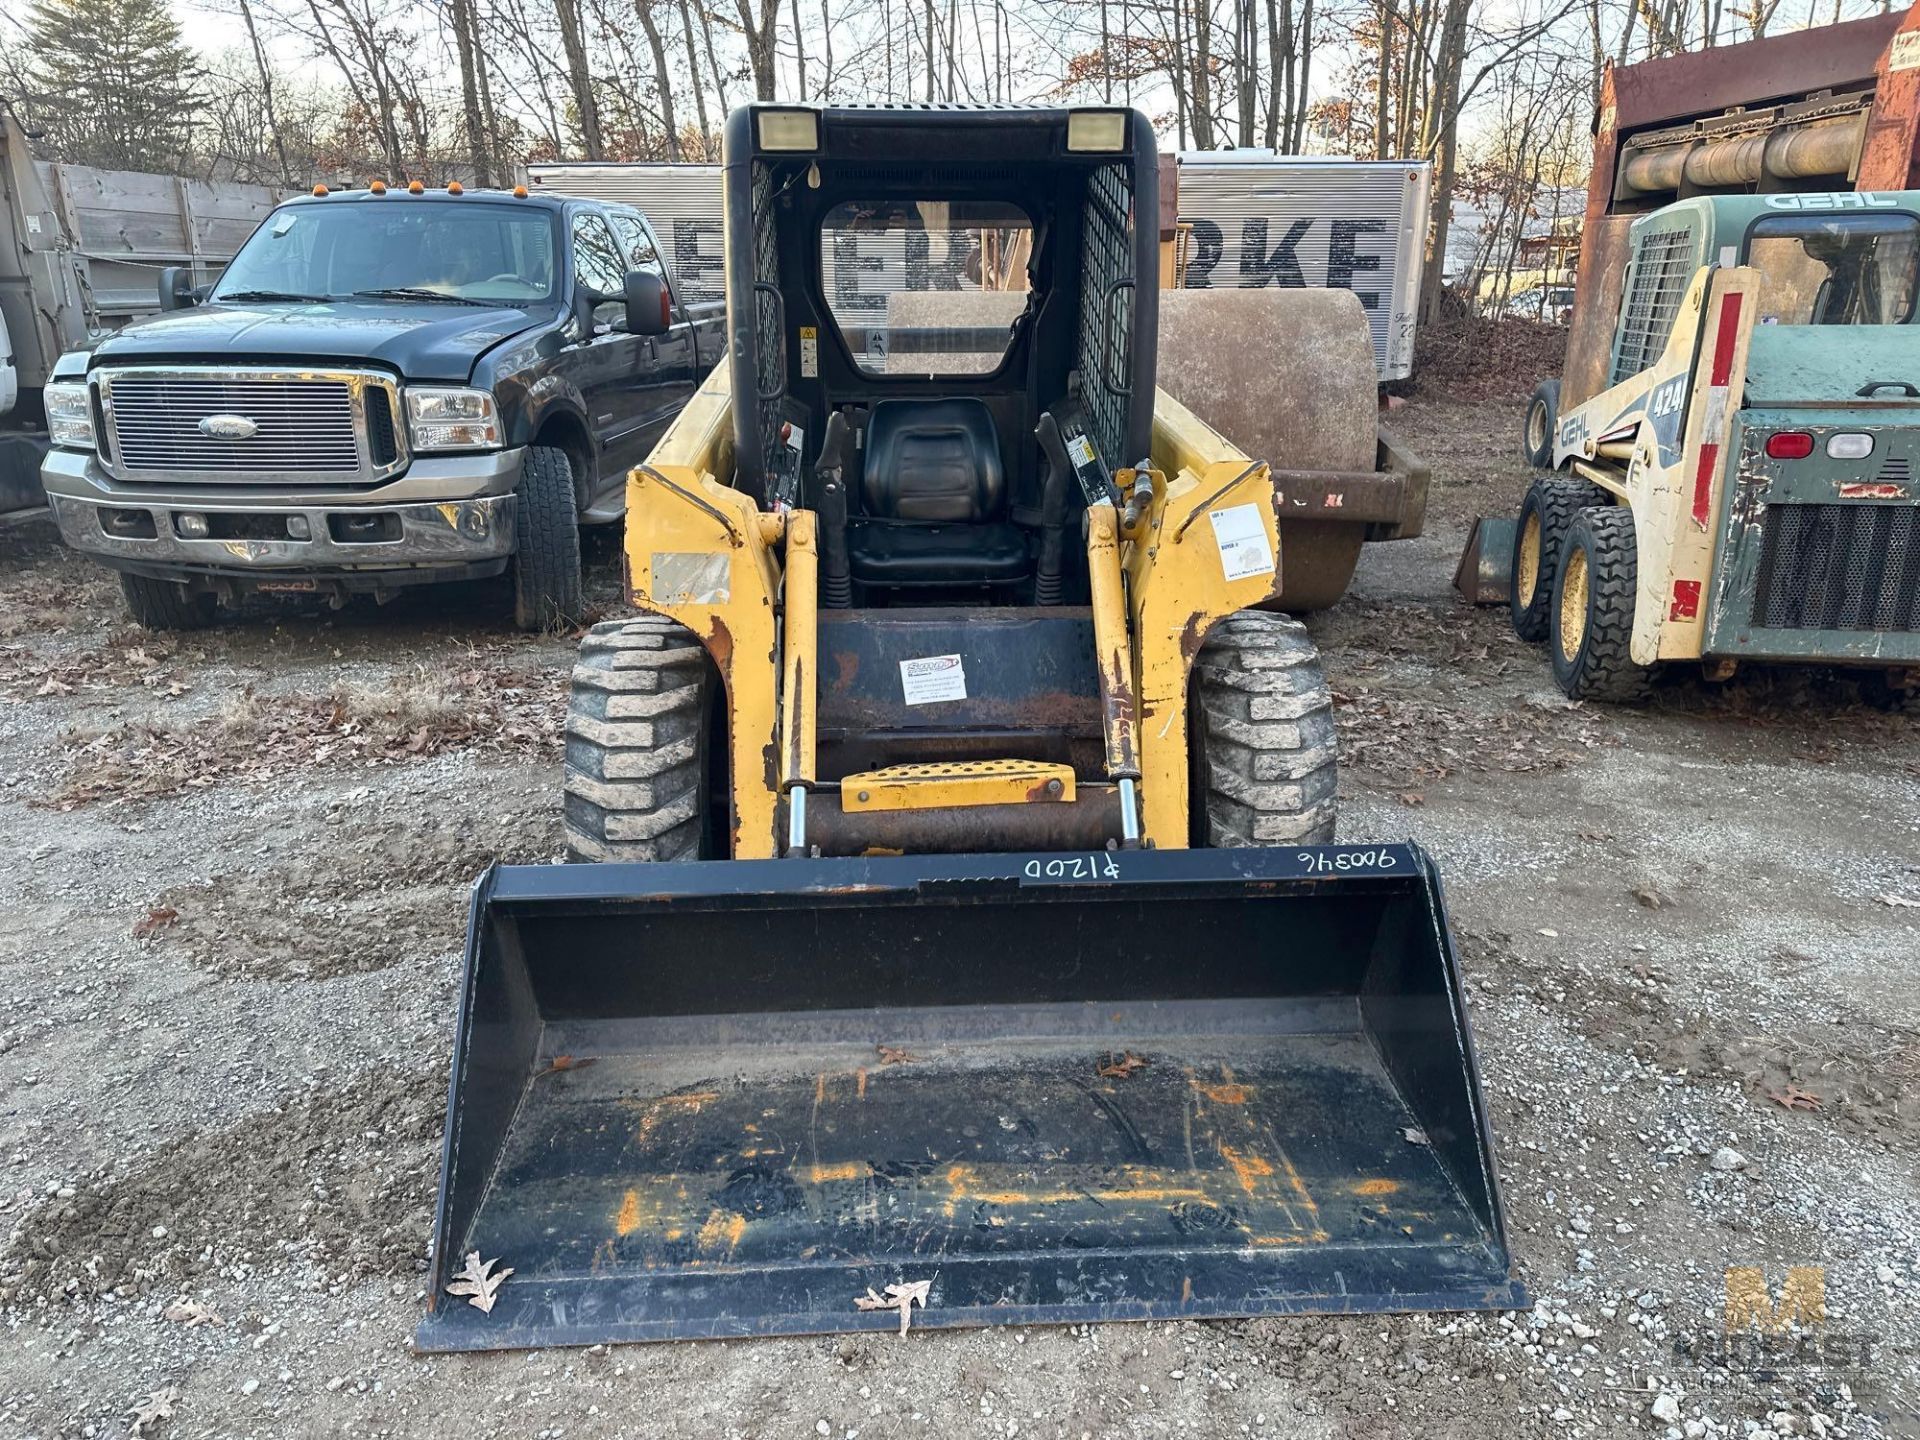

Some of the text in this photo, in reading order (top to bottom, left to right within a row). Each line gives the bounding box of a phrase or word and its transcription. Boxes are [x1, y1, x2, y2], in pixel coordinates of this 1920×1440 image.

[1765, 193, 1898, 209] GEHL
[1561, 411, 1590, 448] GEHL
[1297, 847, 1398, 873] 900346
